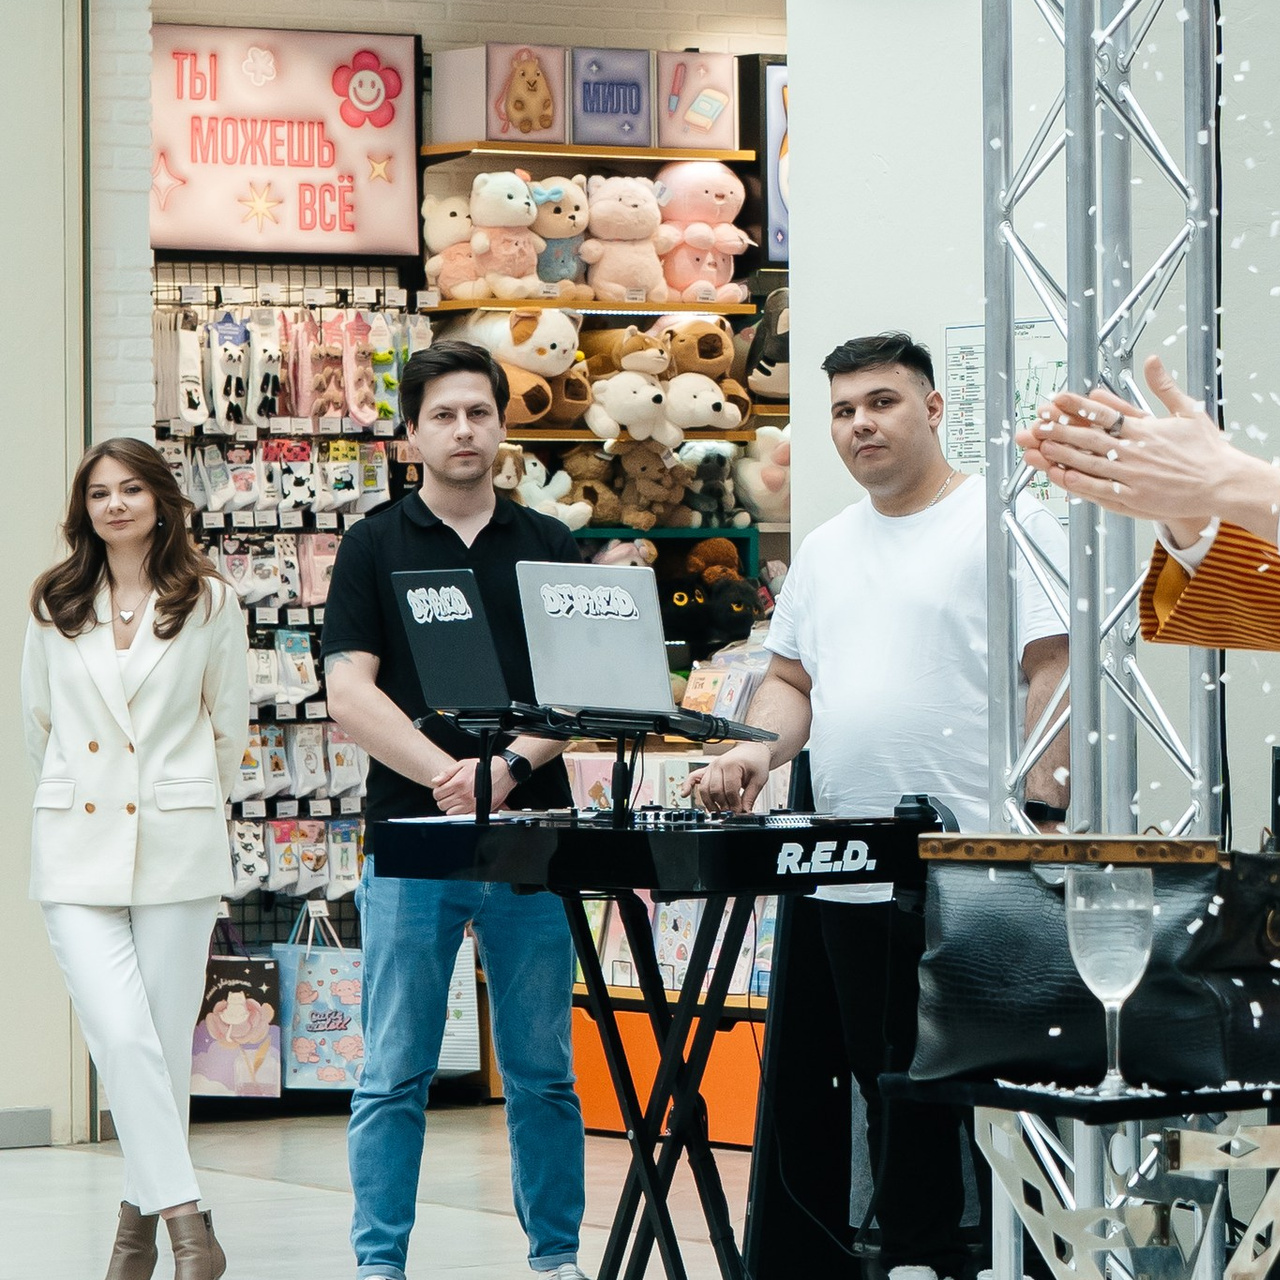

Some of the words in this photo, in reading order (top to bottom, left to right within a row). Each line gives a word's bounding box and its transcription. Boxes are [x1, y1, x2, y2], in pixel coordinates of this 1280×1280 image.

[172, 51, 218, 101] ТЫ
[582, 81, 641, 115] МИЛО
[190, 116, 336, 168] МОЖЕШЬ
[297, 175, 356, 232] ВСЁ
[776, 840, 877, 874] R.E.D.
